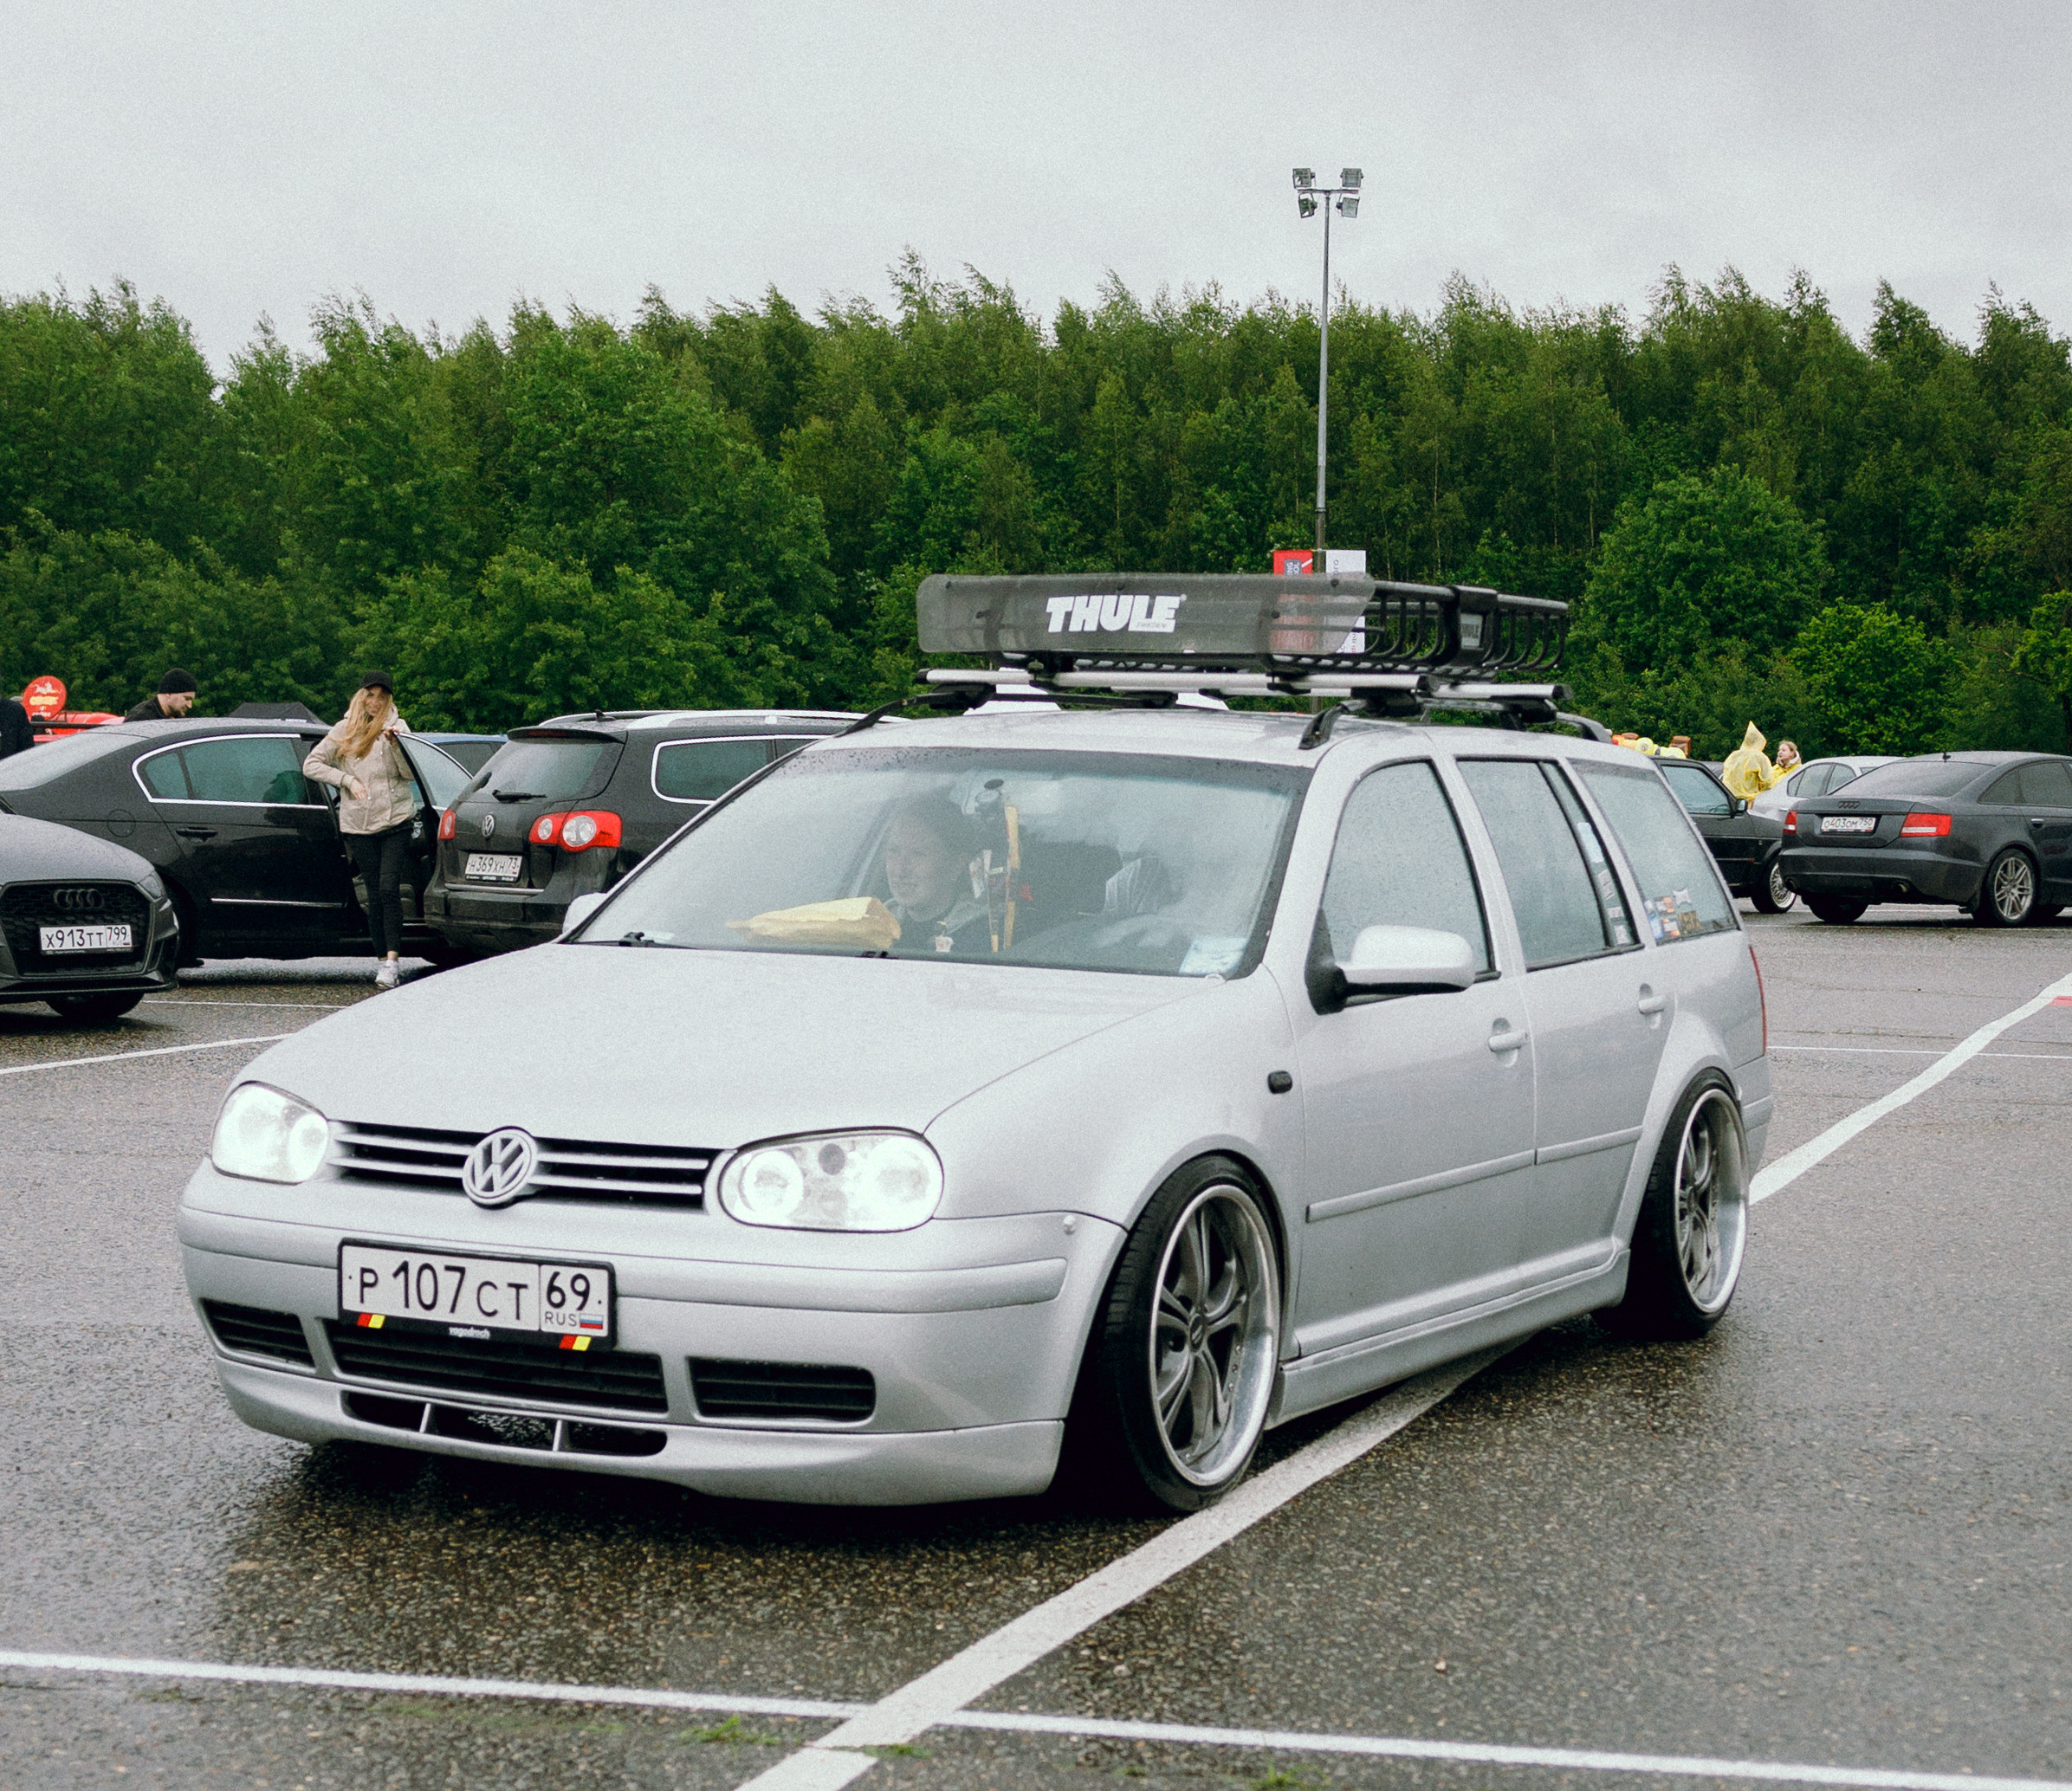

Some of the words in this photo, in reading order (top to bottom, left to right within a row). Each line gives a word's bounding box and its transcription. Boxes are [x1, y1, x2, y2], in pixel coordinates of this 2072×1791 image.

[1046, 595, 1181, 633] THULE
[107, 926, 127, 941] 799
[546, 1271, 592, 1312] 69
[544, 1310, 578, 1328] RUS
